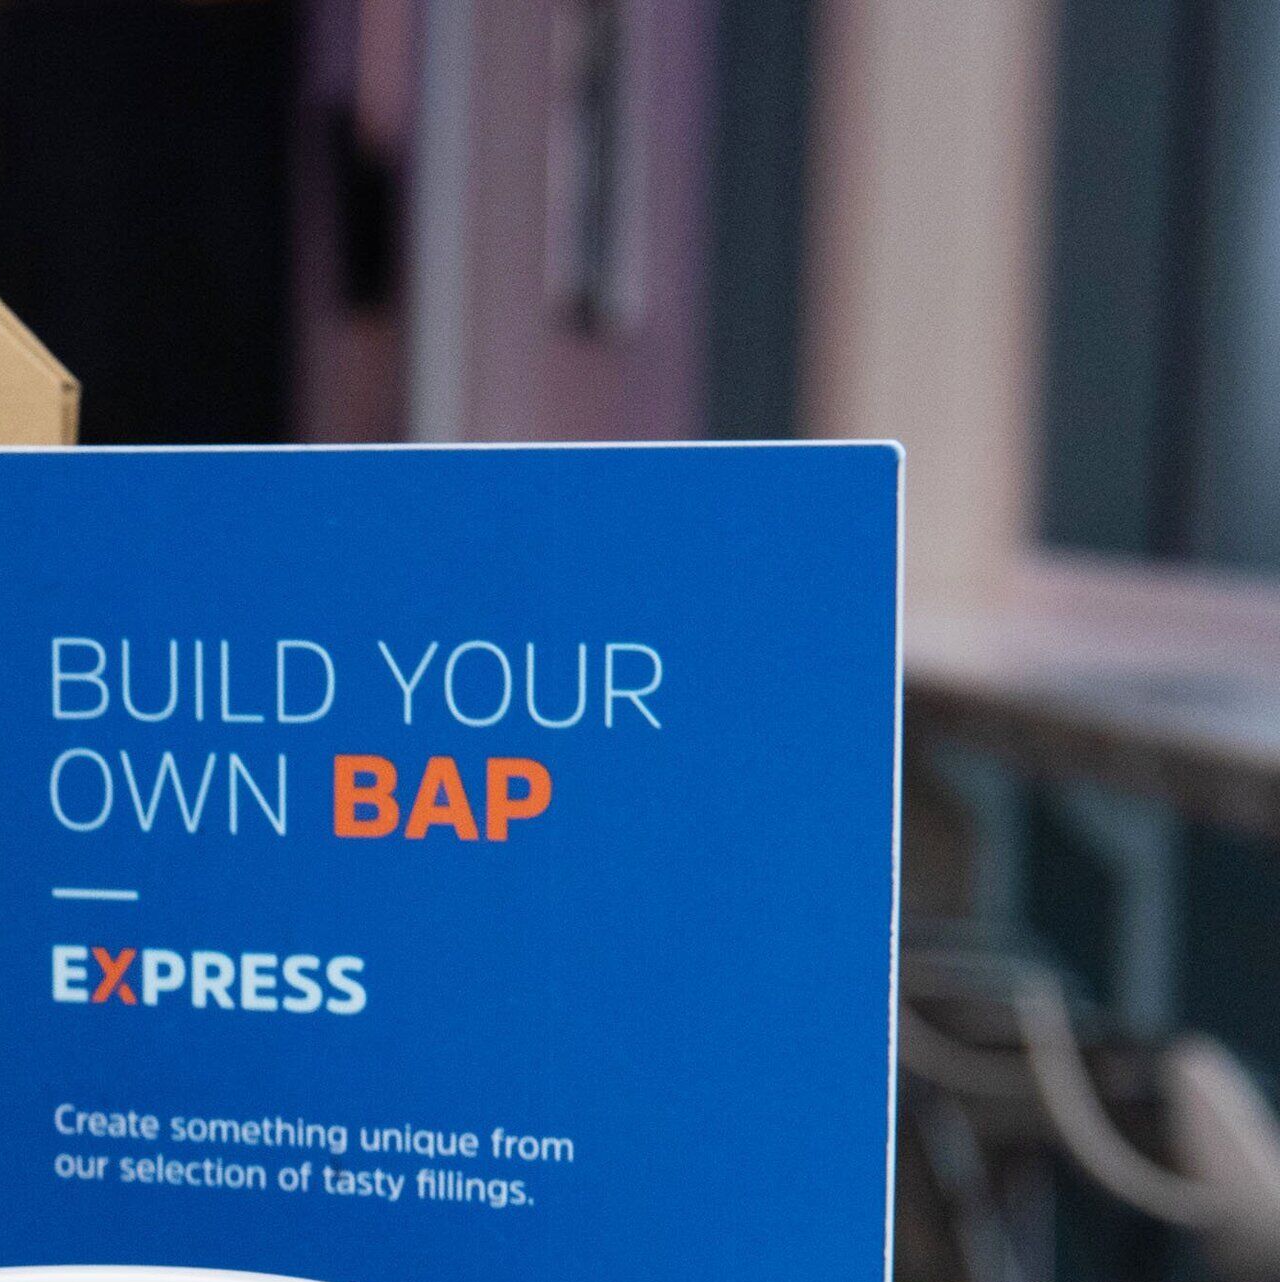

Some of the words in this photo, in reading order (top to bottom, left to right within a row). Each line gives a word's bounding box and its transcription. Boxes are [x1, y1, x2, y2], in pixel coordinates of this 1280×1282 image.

[51, 636, 337, 724] BUILD
[377, 639, 664, 729] YOUR
[49, 746, 287, 836] OWN
[333, 754, 554, 842] BAP
[51, 944, 368, 1015] EXPRESS
[53, 1103, 160, 1140] Create
[170, 1116, 348, 1154] something
[360, 1123, 480, 1158] unique
[491, 1127, 575, 1163] from
[53, 1153, 109, 1181] our
[119, 1153, 267, 1190] selection
[278, 1161, 313, 1192] of
[322, 1163, 405, 1201] tasty
[417, 1169, 536, 1209] fillings.
